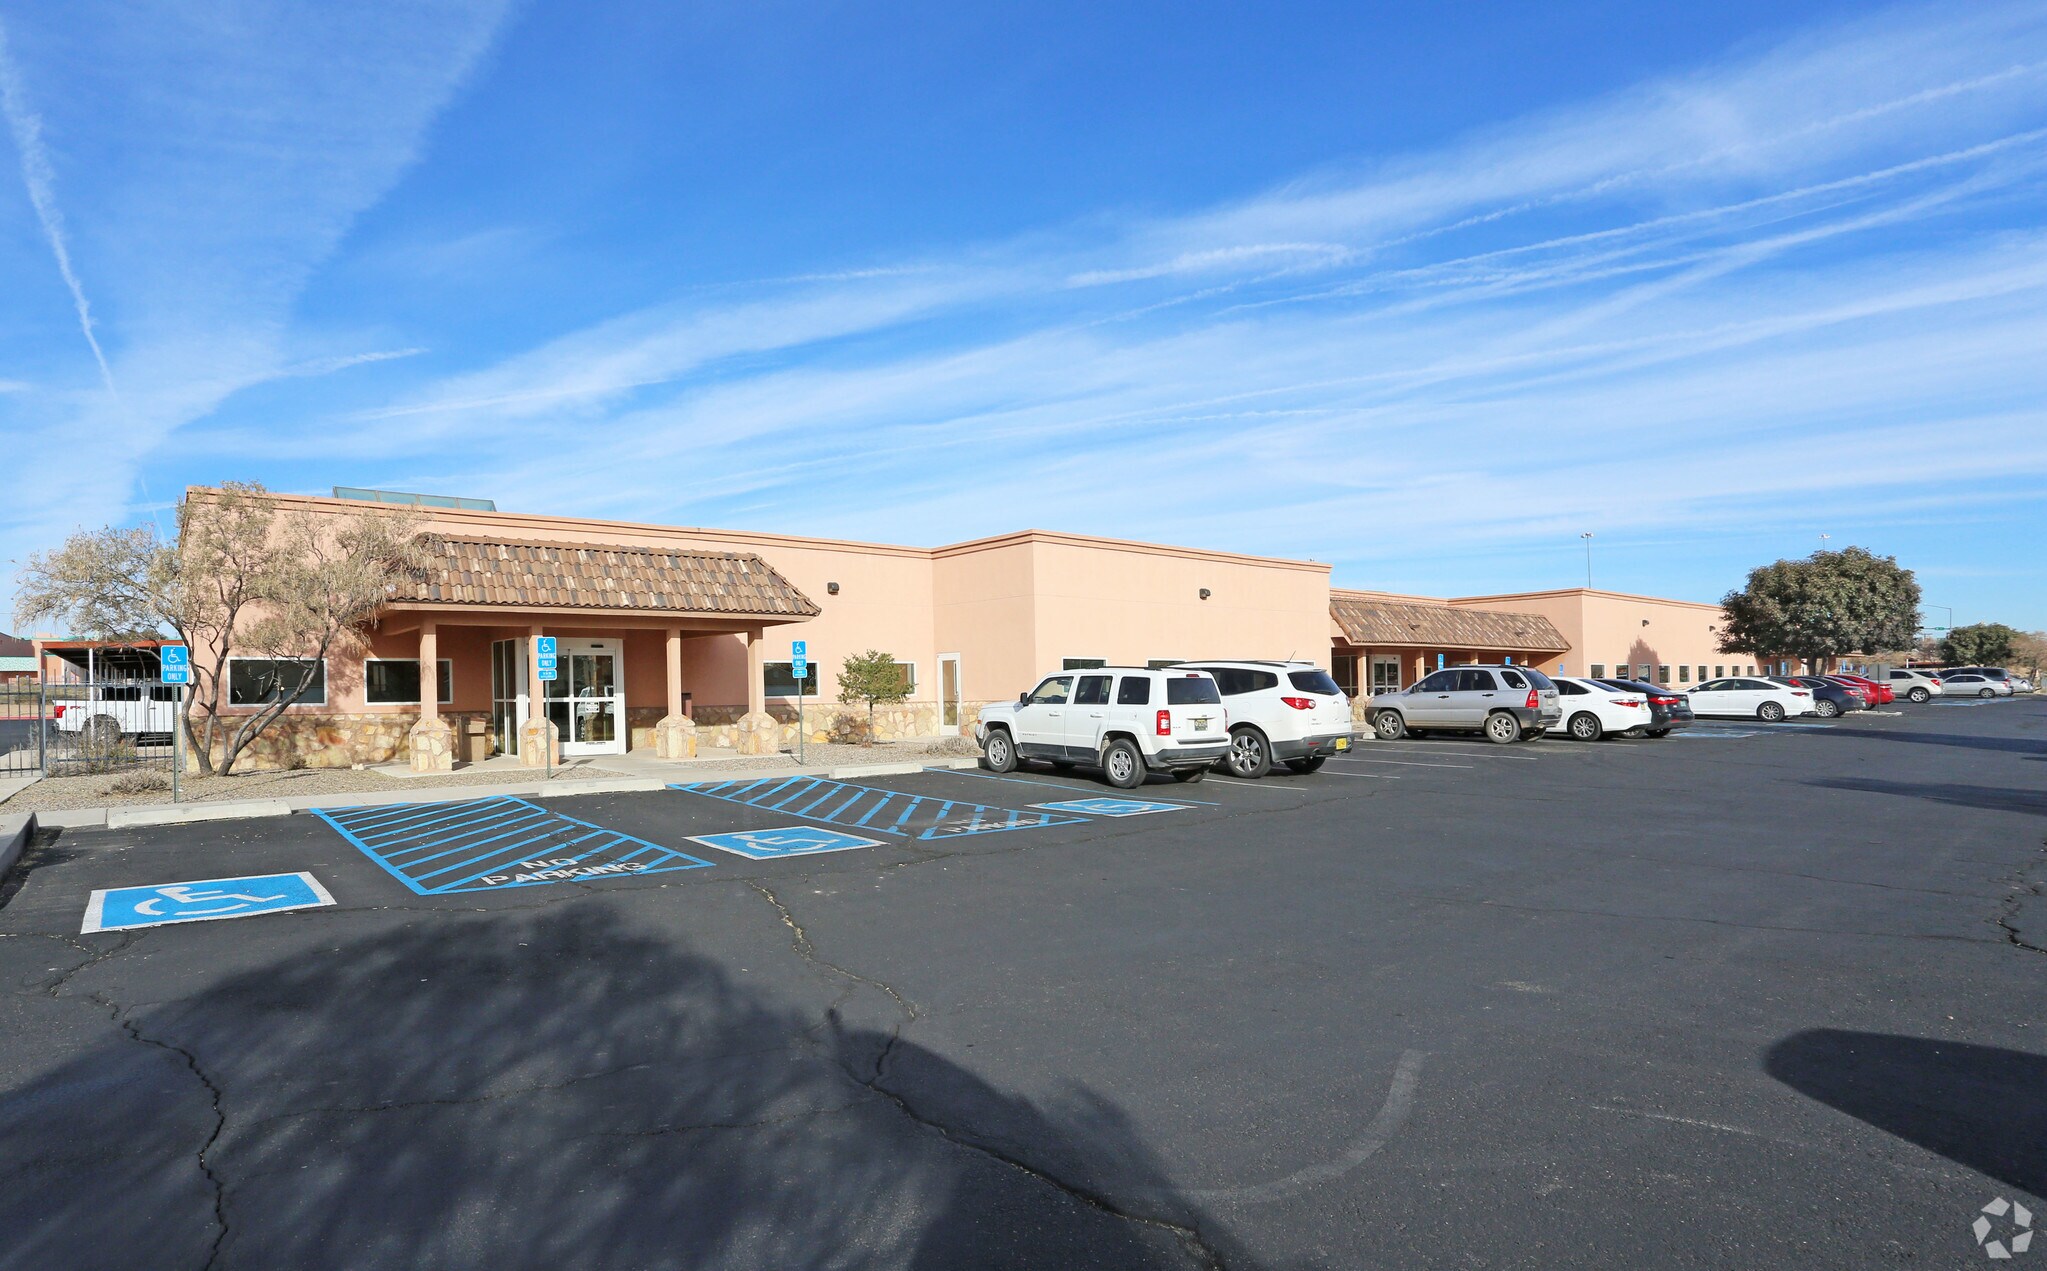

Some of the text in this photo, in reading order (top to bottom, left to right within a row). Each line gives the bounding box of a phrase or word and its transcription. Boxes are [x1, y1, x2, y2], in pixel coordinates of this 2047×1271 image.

[162, 664, 187, 672] PARKING
[167, 673, 182, 681] ONLY
[519, 858, 578, 869] NO
[481, 862, 648, 885] PARKING
